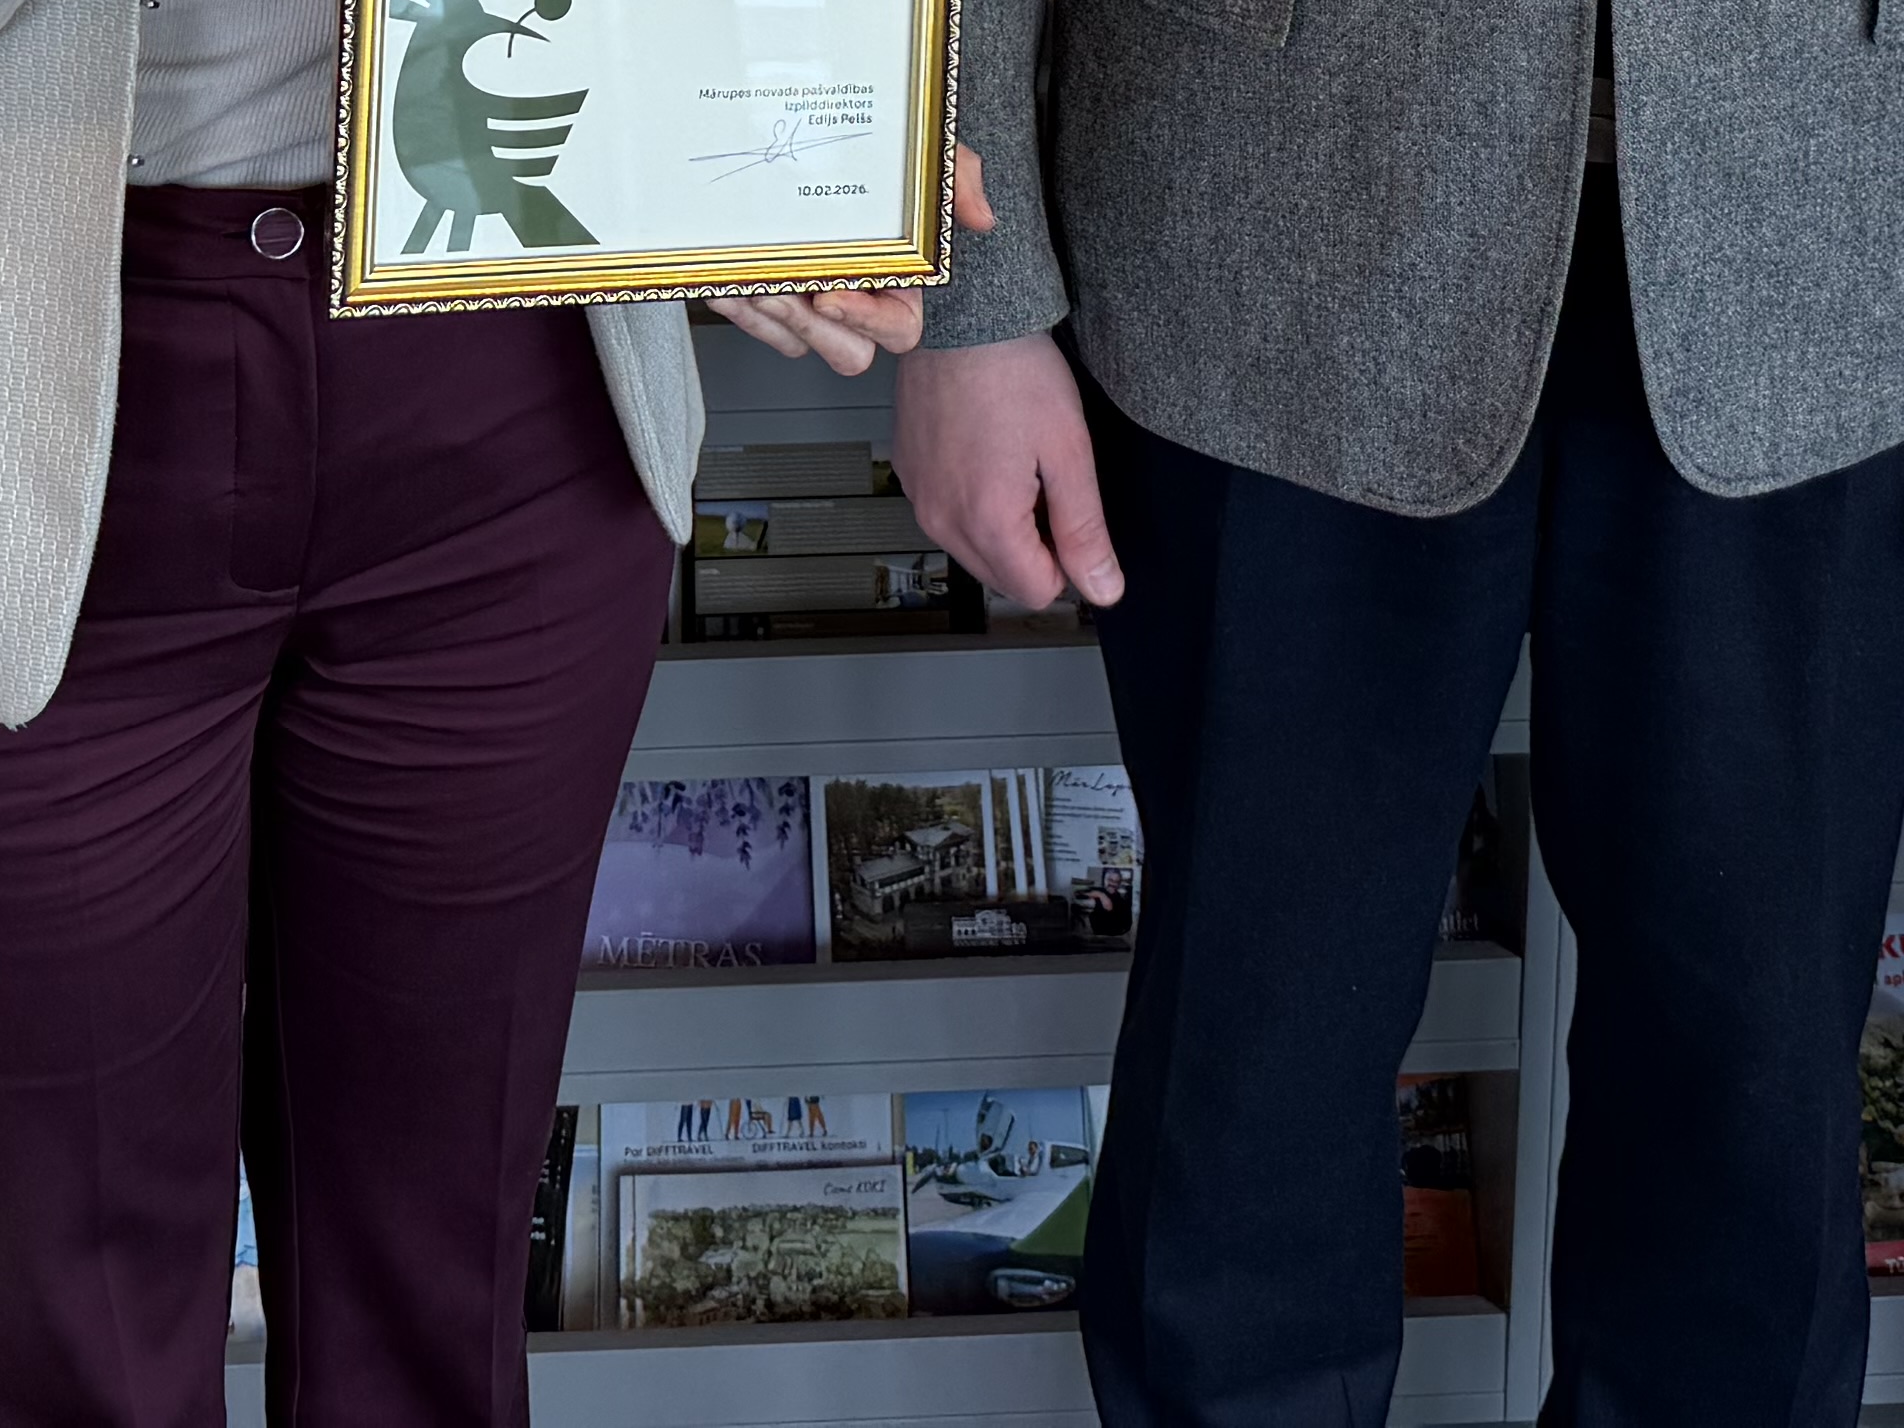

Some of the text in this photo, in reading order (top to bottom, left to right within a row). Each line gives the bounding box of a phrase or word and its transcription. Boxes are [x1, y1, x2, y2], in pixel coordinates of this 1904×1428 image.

[699, 83, 874, 102] Mārupes novada pašvaldības
[808, 113, 838, 128] Edijs
